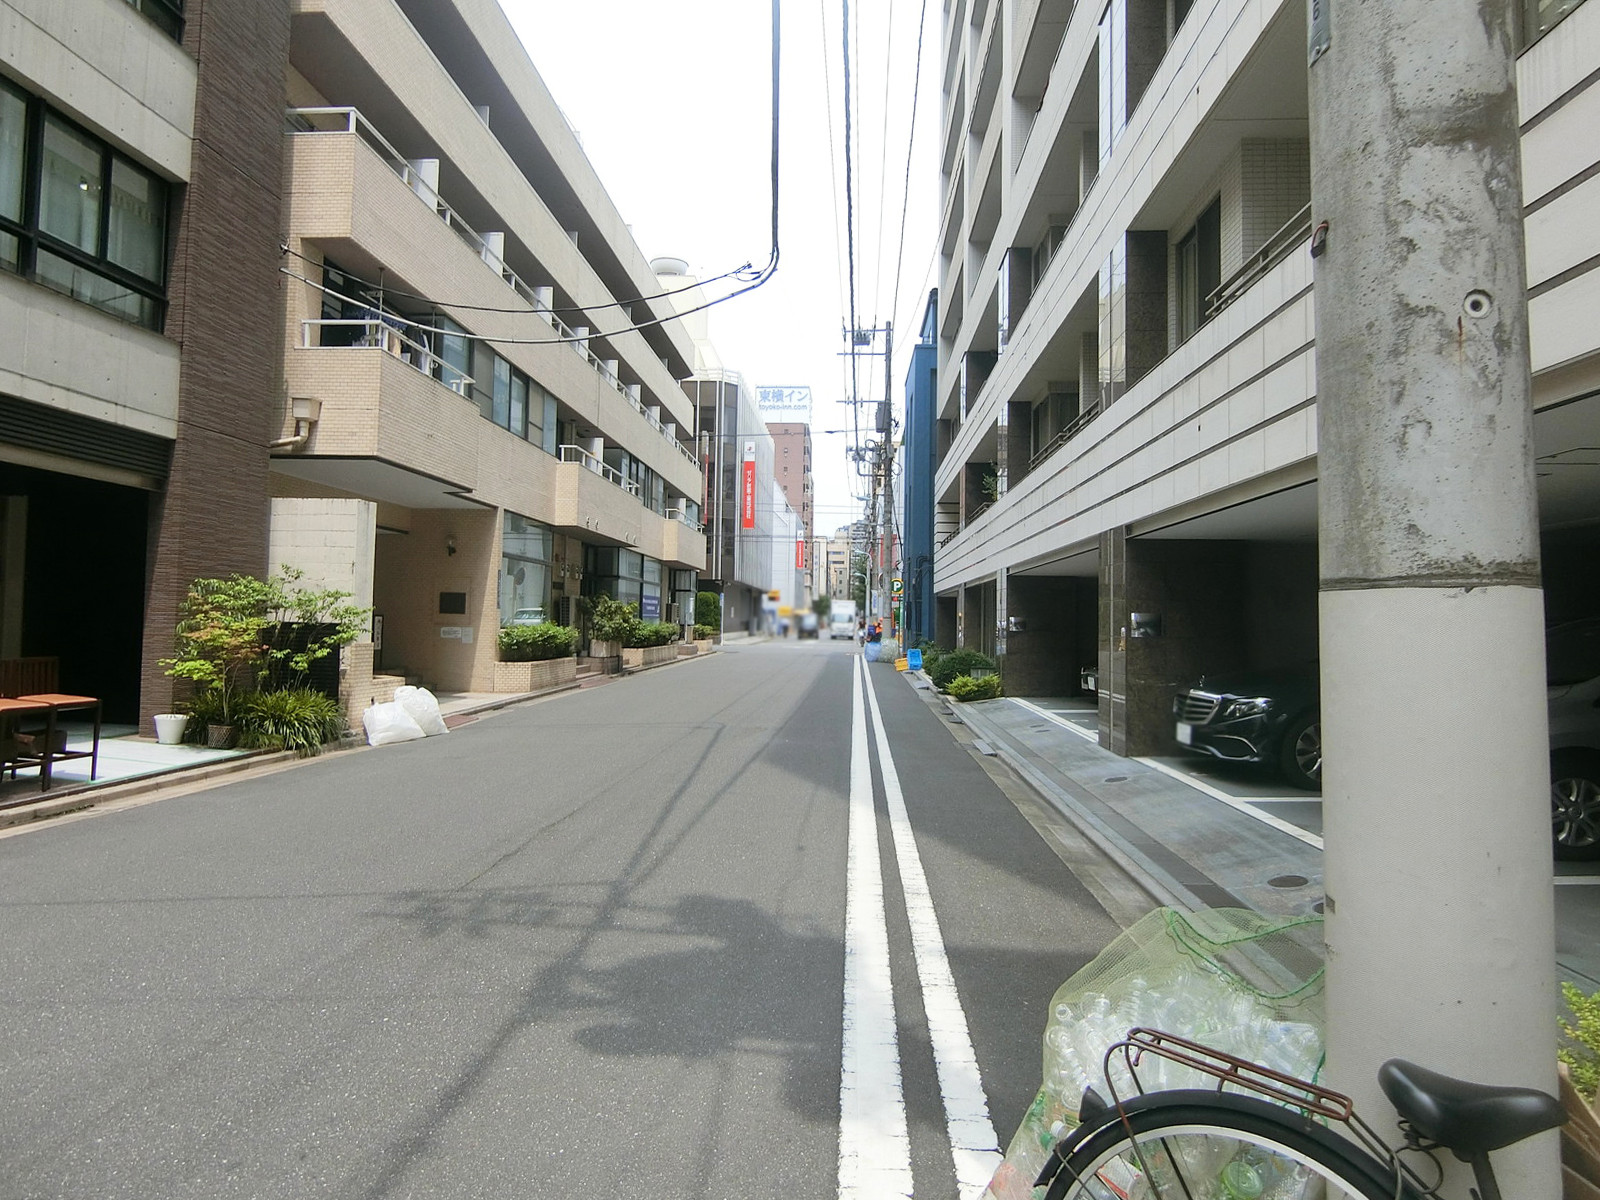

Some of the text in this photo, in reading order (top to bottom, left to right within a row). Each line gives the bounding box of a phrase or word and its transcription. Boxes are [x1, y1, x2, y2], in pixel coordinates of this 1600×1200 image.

[758, 389, 809, 403] 東横イン
[758, 403, 808, 412] toyoko-inn.com
[893, 581, 902, 592] P
